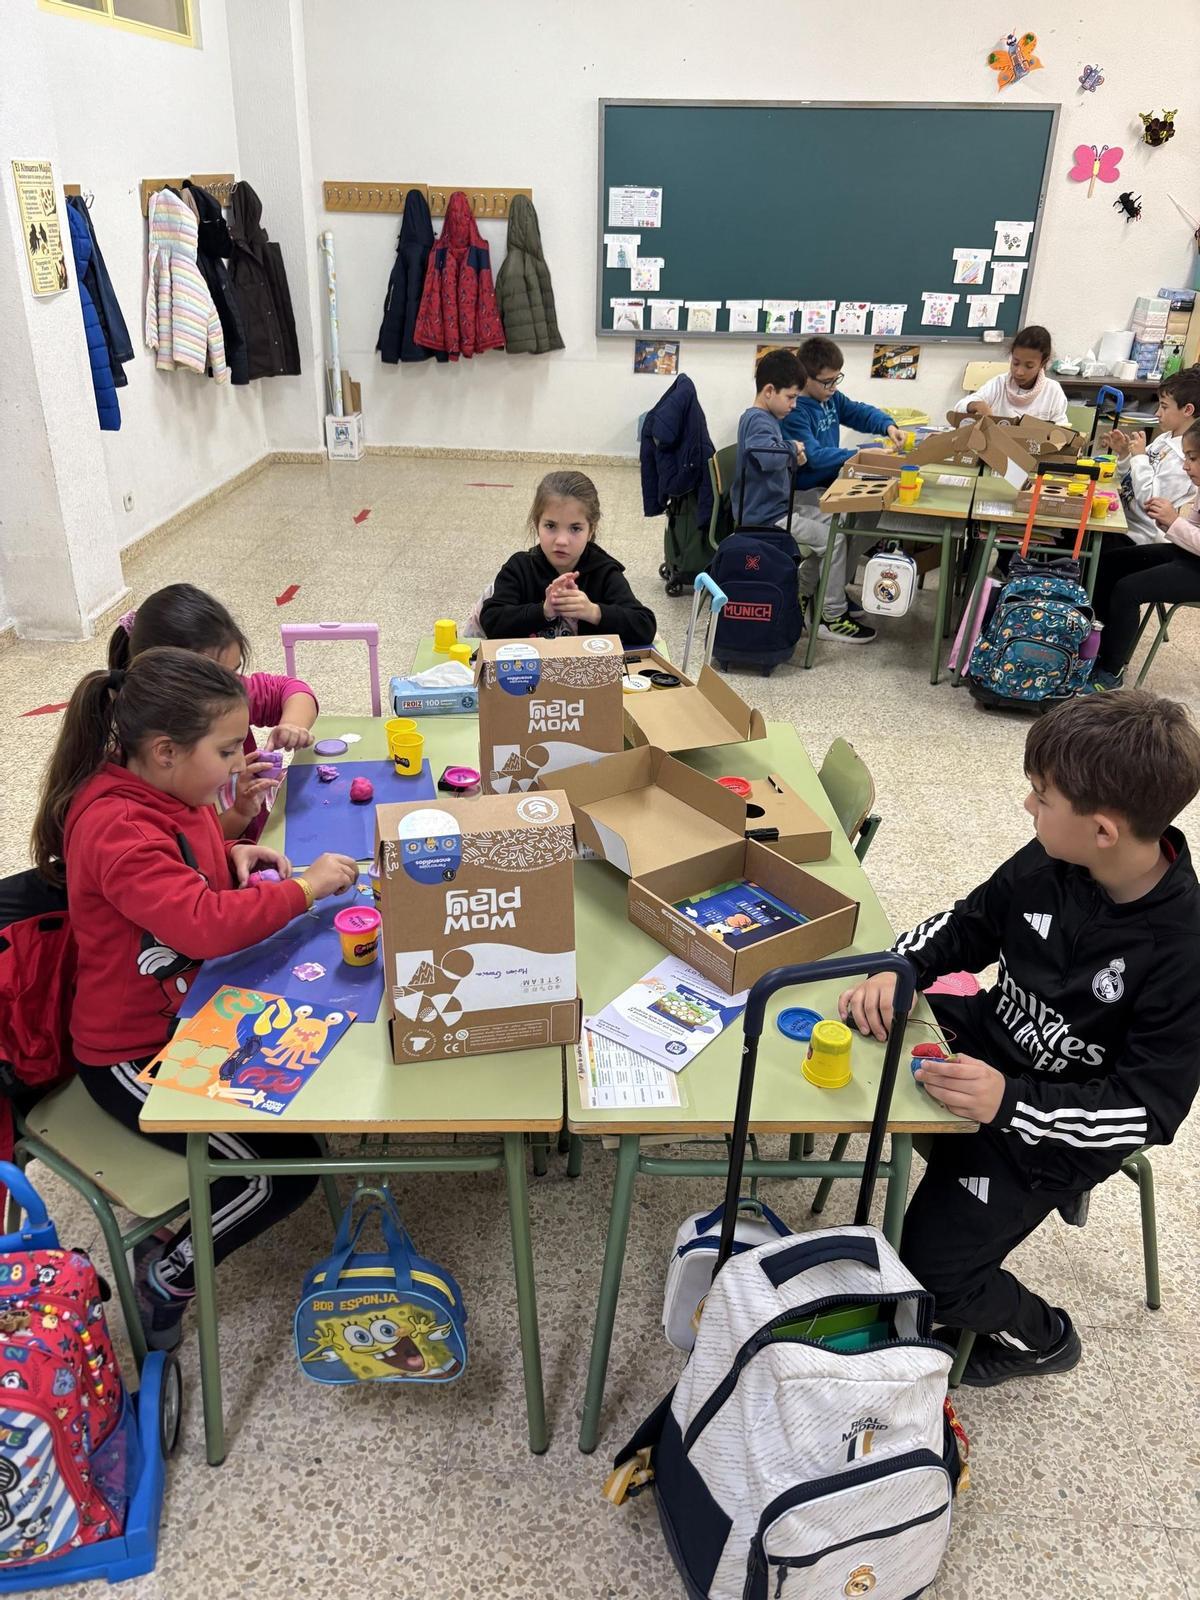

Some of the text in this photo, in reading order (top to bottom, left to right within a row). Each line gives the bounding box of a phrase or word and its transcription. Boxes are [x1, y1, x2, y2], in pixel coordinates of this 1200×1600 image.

[725, 604, 771, 618] MUNICH
[426, 699, 440, 707] 100
[415, 856, 452, 866] encendidos
[522, 976, 560, 986] STEAM
[996, 994, 1068, 1074] FLY BETTER
[313, 1293, 400, 1312] BOB ESPONJA
[851, 1416, 880, 1430] REAL
[842, 1423, 889, 1443] MADRID
